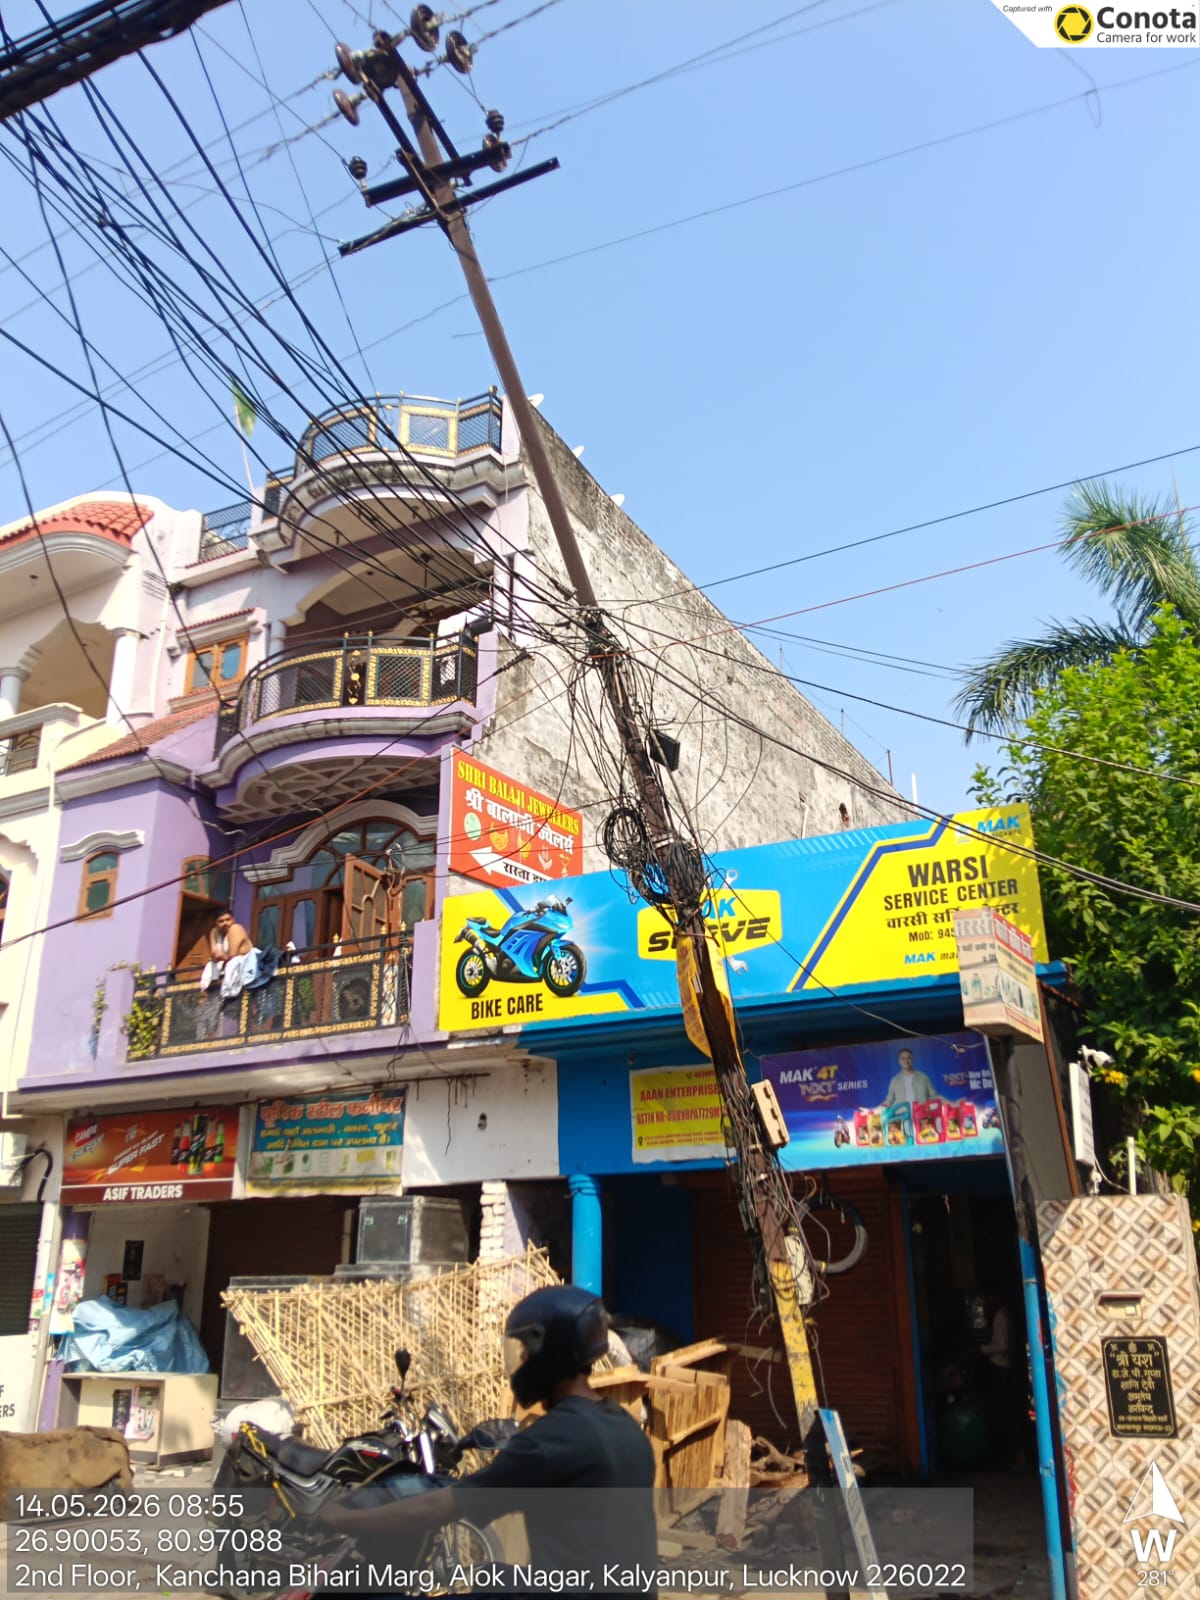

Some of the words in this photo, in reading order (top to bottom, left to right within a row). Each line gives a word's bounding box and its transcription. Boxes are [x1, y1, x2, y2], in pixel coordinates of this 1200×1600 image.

[458, 760, 486, 789] SHRI
[489, 775, 525, 809] BALAJI
[527, 799, 579, 836] JEWELLERS
[465, 787, 484, 812] श्री
[977, 815, 1020, 833] MAK
[502, 861, 530, 881] रास्ता
[907, 854, 988, 888] WARSI
[883, 888, 949, 911] SERVICE
[957, 879, 1018, 902] CENTER
[886, 911, 928, 929] वारसी
[908, 931, 934, 943] Mob:
[904, 952, 936, 964] MAK
[471, 998, 502, 1020] BIKE
[507, 993, 543, 1015] CARE
[780, 1068, 814, 1084] MAK
[837, 1080, 868, 1091] SERIES
[103, 1188, 128, 1201] ASIF
[130, 1185, 183, 1199] TRADERS
